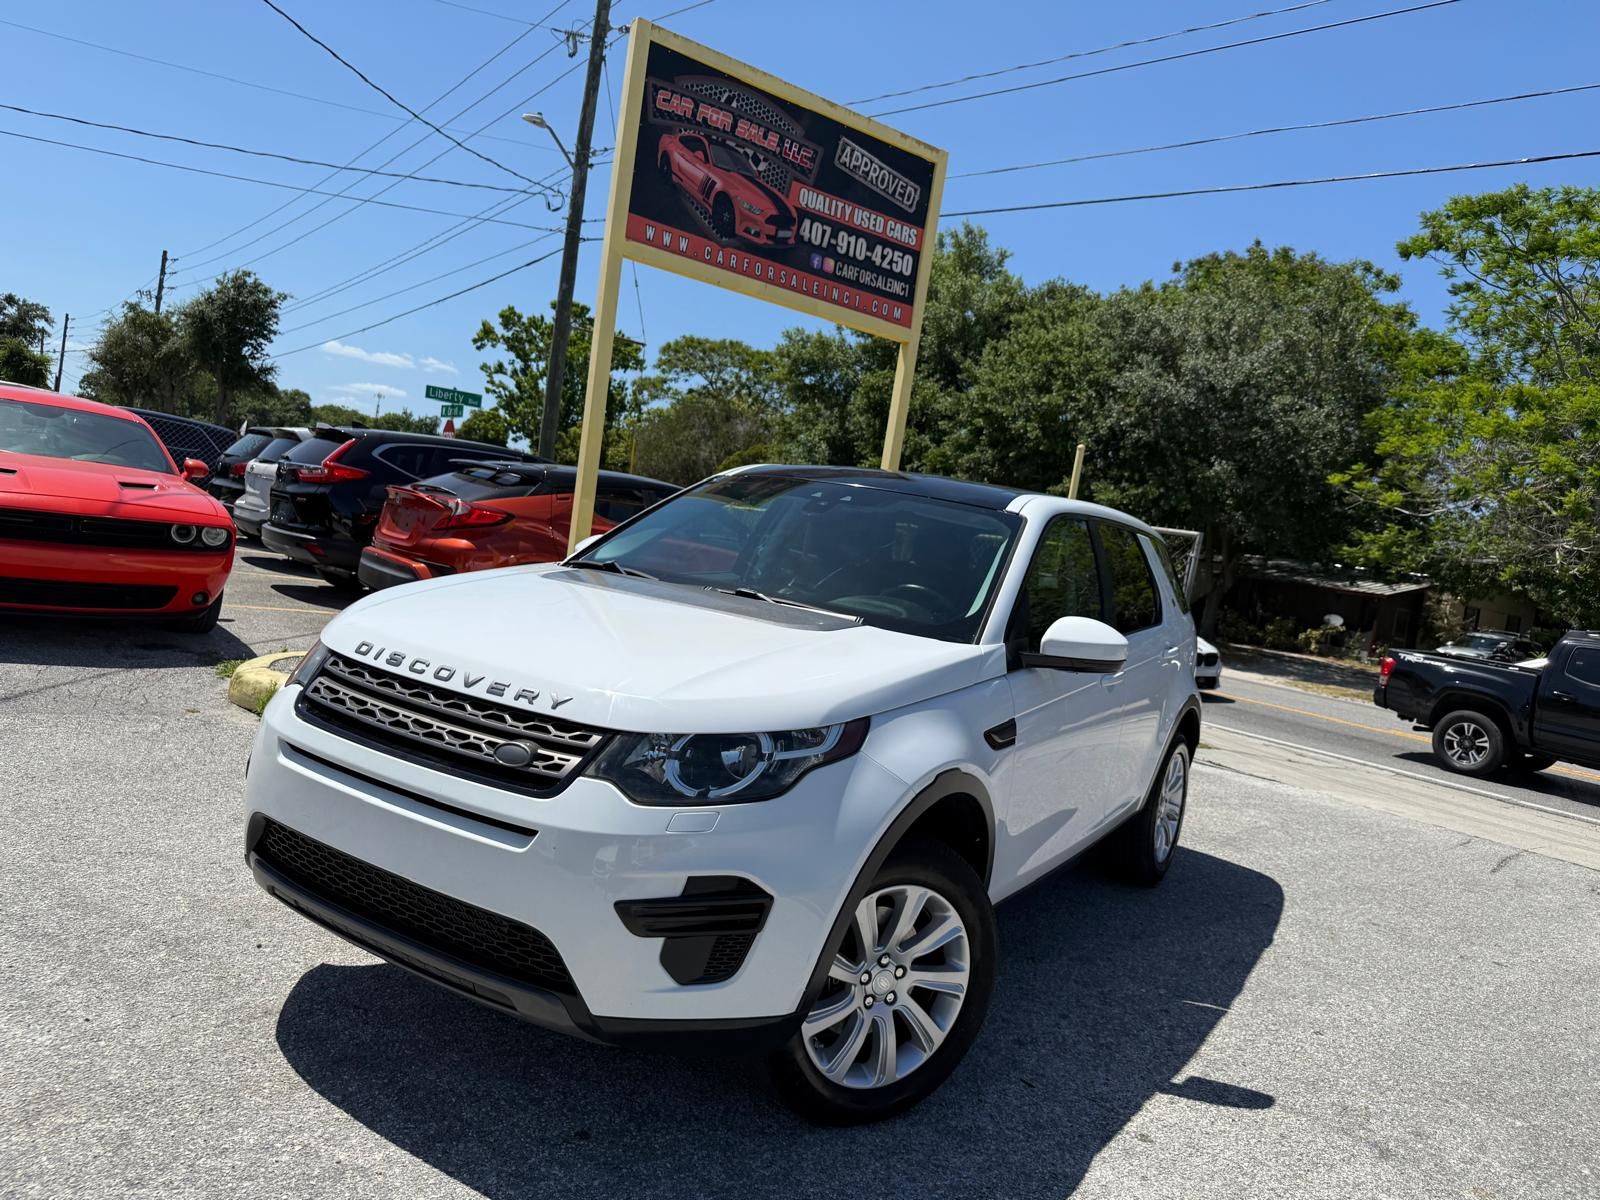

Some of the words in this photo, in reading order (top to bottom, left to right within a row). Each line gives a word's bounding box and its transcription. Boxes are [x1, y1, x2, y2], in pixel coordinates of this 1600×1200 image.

[656, 89, 694, 118] CAR
[697, 103, 734, 132] FOR
[840, 146, 915, 206] APPROVED
[799, 187, 853, 222] QUALITY
[853, 207, 884, 233] USED
[886, 220, 918, 246] CARS
[800, 218, 913, 276] 407-910-4250
[835, 261, 910, 297] CARFORSALEINC1
[429, 387, 464, 404] Liberty
[354, 640, 574, 710] DISCOVERY
